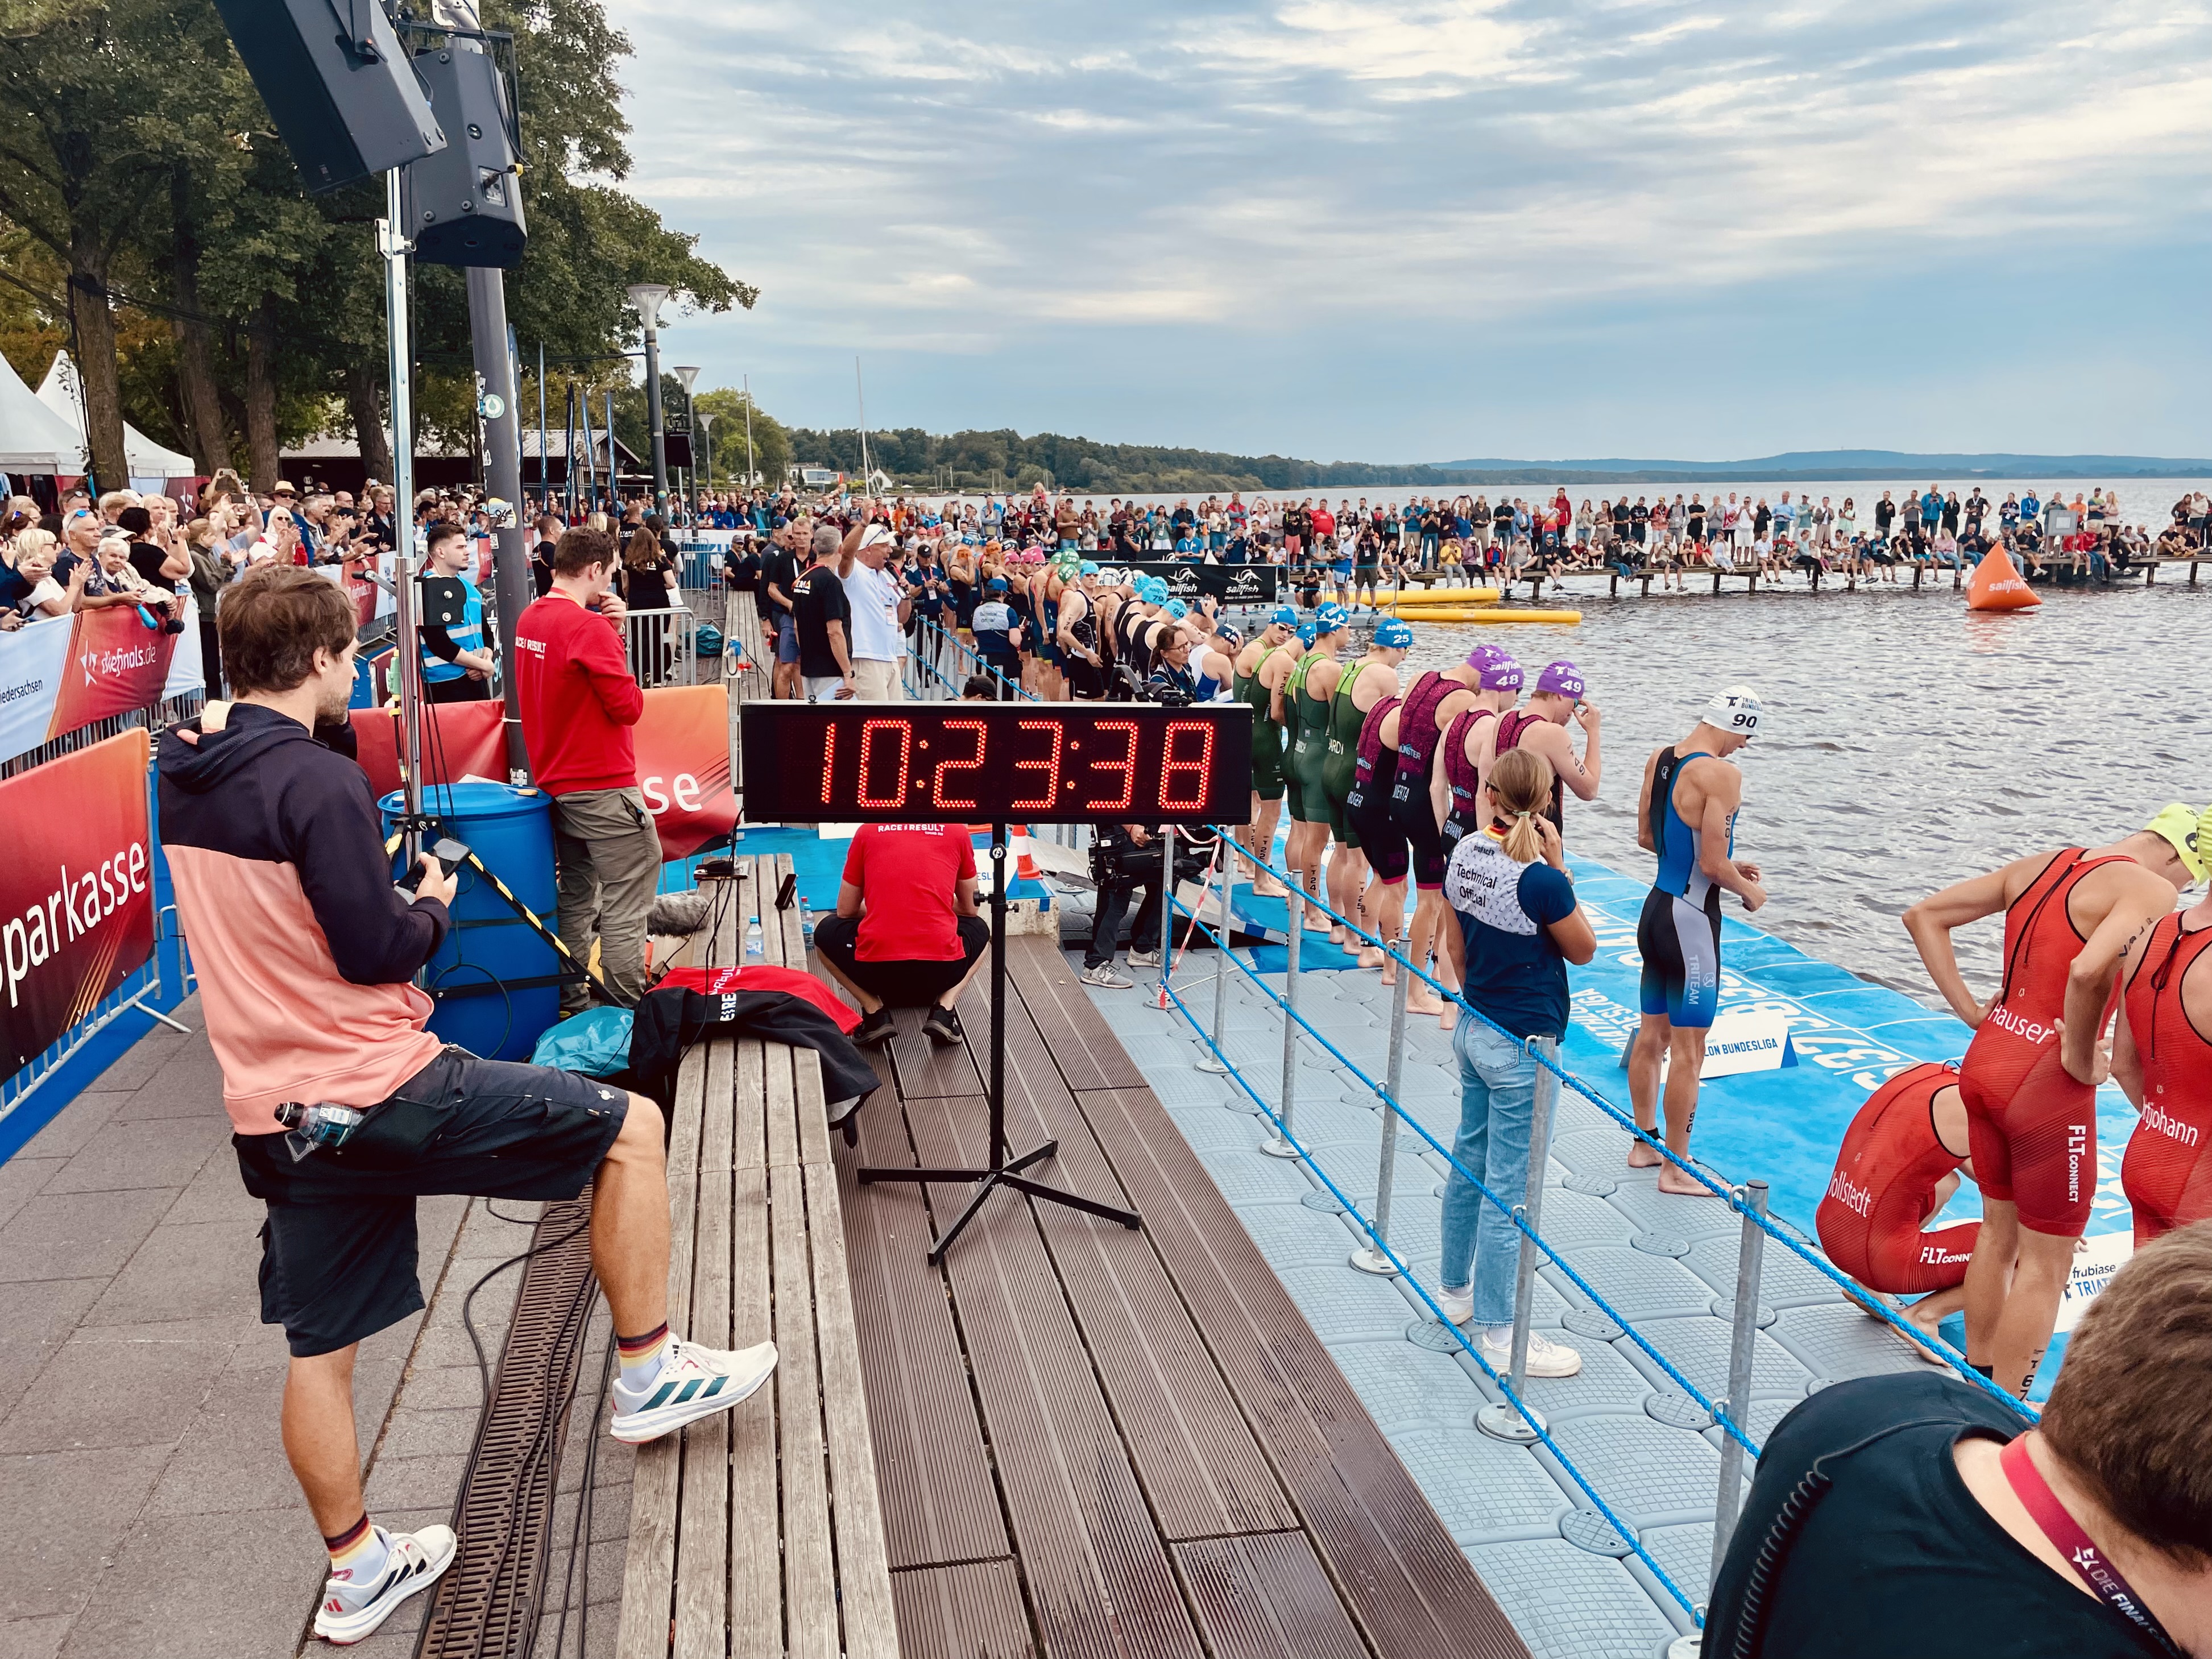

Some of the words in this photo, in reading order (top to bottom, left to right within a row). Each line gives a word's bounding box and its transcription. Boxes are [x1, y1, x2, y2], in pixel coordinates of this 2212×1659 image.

[1167, 583, 1198, 595] sailfish
[1226, 584, 1260, 596] sailfish
[1989, 579, 2025, 594] sailfish
[1173, 608, 1184, 617] 80
[1393, 634, 1410, 644] 25
[101, 641, 156, 678] diefinals.de
[1496, 674, 1519, 687] 48
[1560, 680, 1581, 692] 49
[1732, 714, 1758, 728] 90
[821, 719, 1215, 810] 10:23:38
[878, 824, 902, 833] RACE
[1456, 862, 1498, 890] Technical
[1459, 885, 1486, 908] Official
[0, 841, 147, 1009] parkasse
[1688, 954, 1701, 1005] TRITEAM
[1987, 999, 2056, 1044] Hauser
[1723, 1038, 1779, 1054] BUNDESLIGA
[2090, 1567, 2119, 1594] DIE
